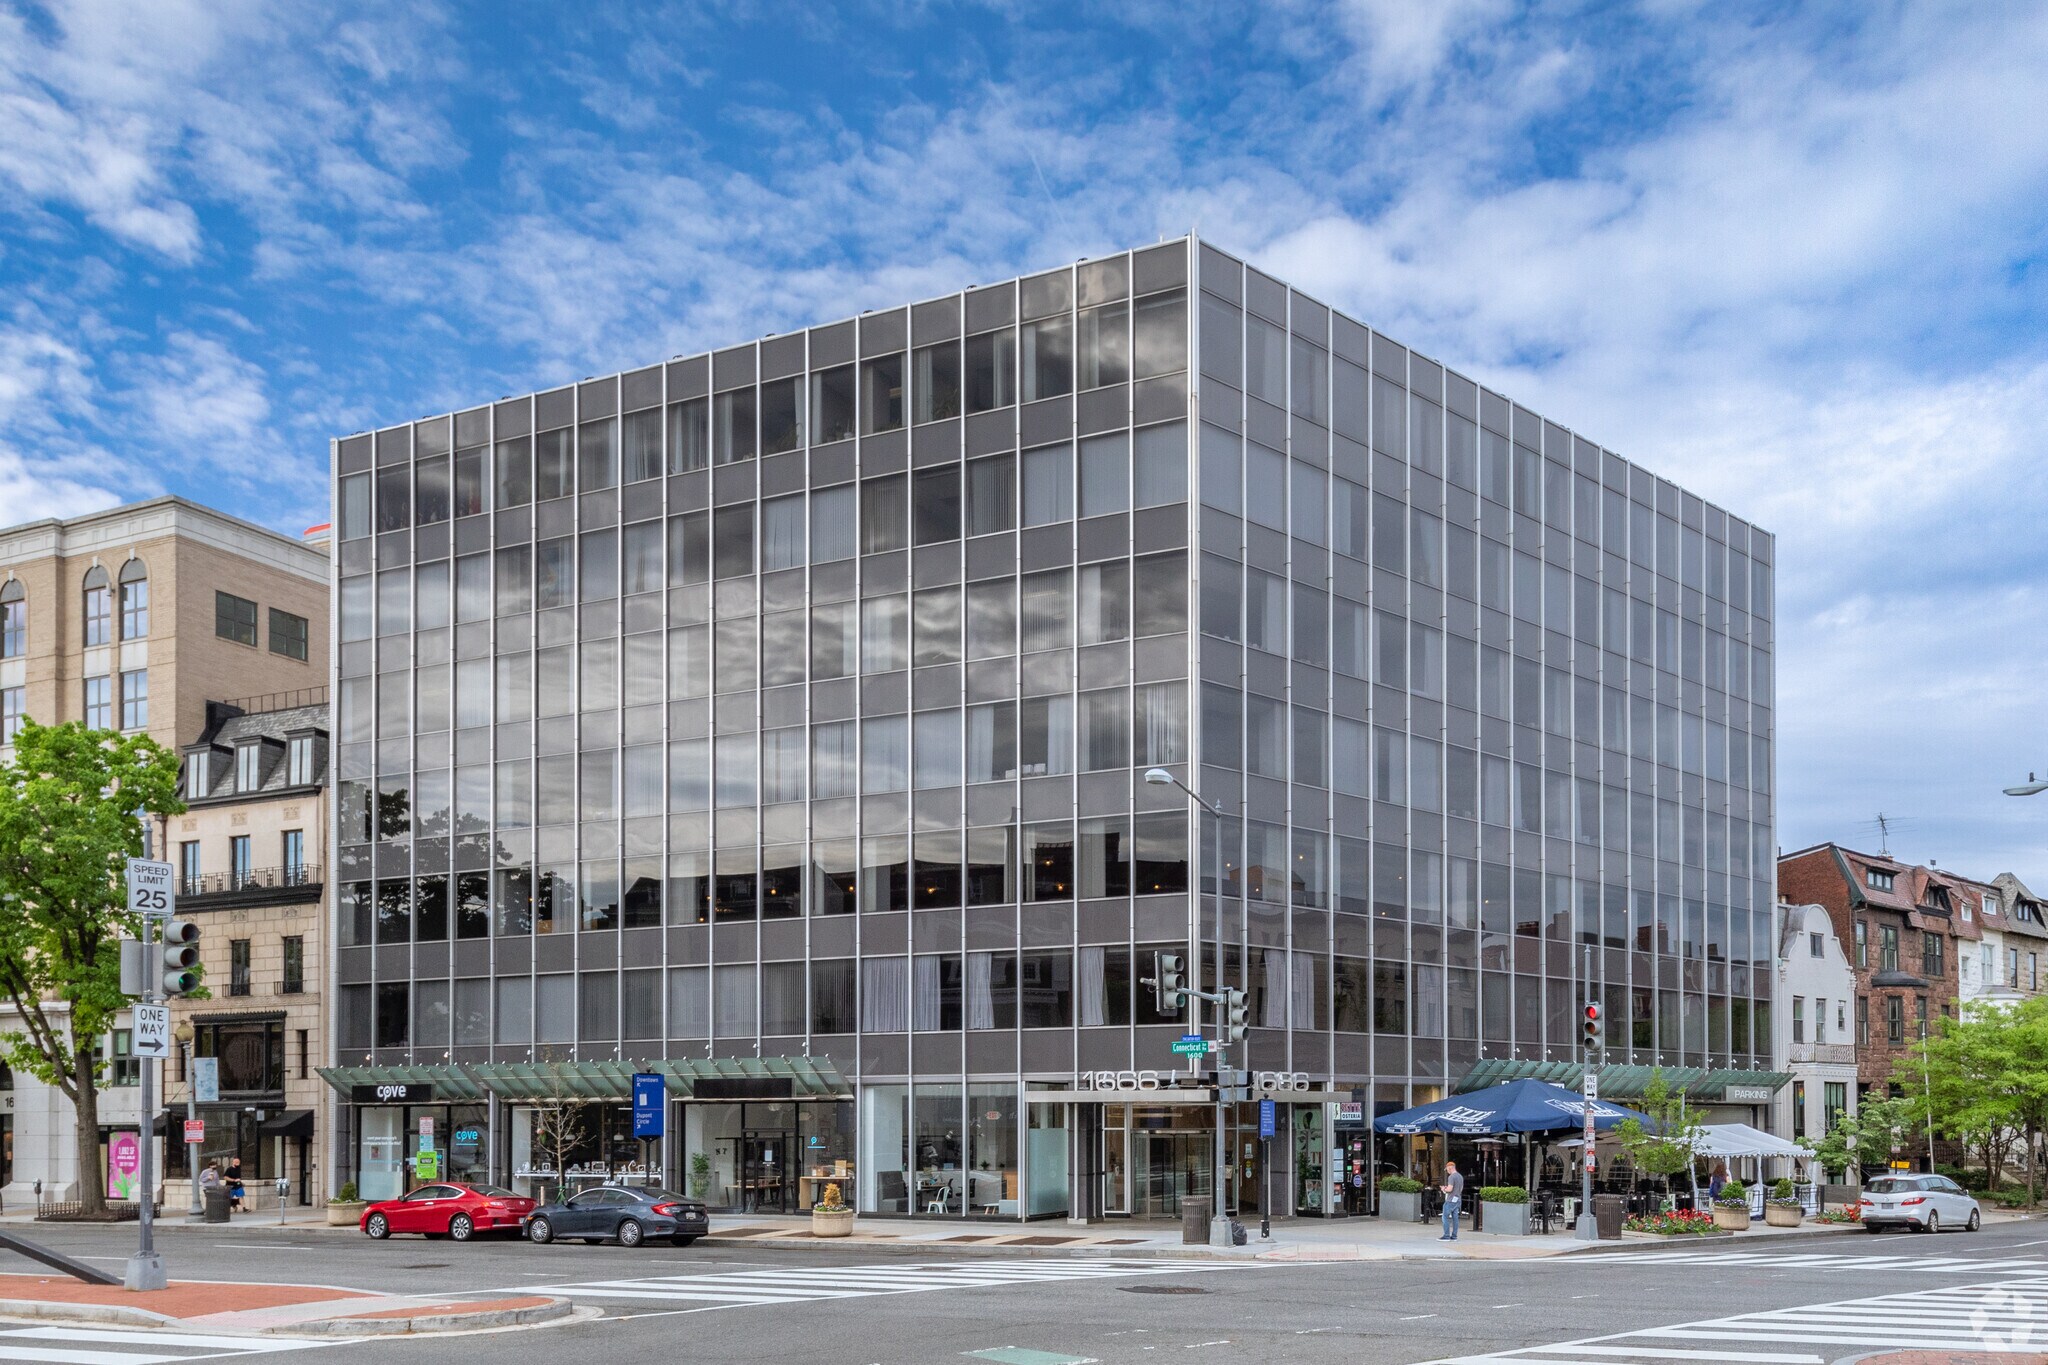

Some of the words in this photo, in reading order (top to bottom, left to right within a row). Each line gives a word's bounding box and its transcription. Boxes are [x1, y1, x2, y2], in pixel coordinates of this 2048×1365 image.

[133, 864, 169, 876] SPEED
[137, 875, 165, 885] LIMIT
[136, 888, 167, 910] 25
[140, 1008, 164, 1022] ONE
[140, 1022, 165, 1035] WAY
[1172, 1043, 1201, 1052] Connecticut
[1082, 1070, 1161, 1092] 1666
[1586, 1076, 1596, 1084] ONE
[376, 1085, 407, 1102] cove
[1734, 1089, 1768, 1099] PARKING
[455, 1130, 478, 1141] cove
